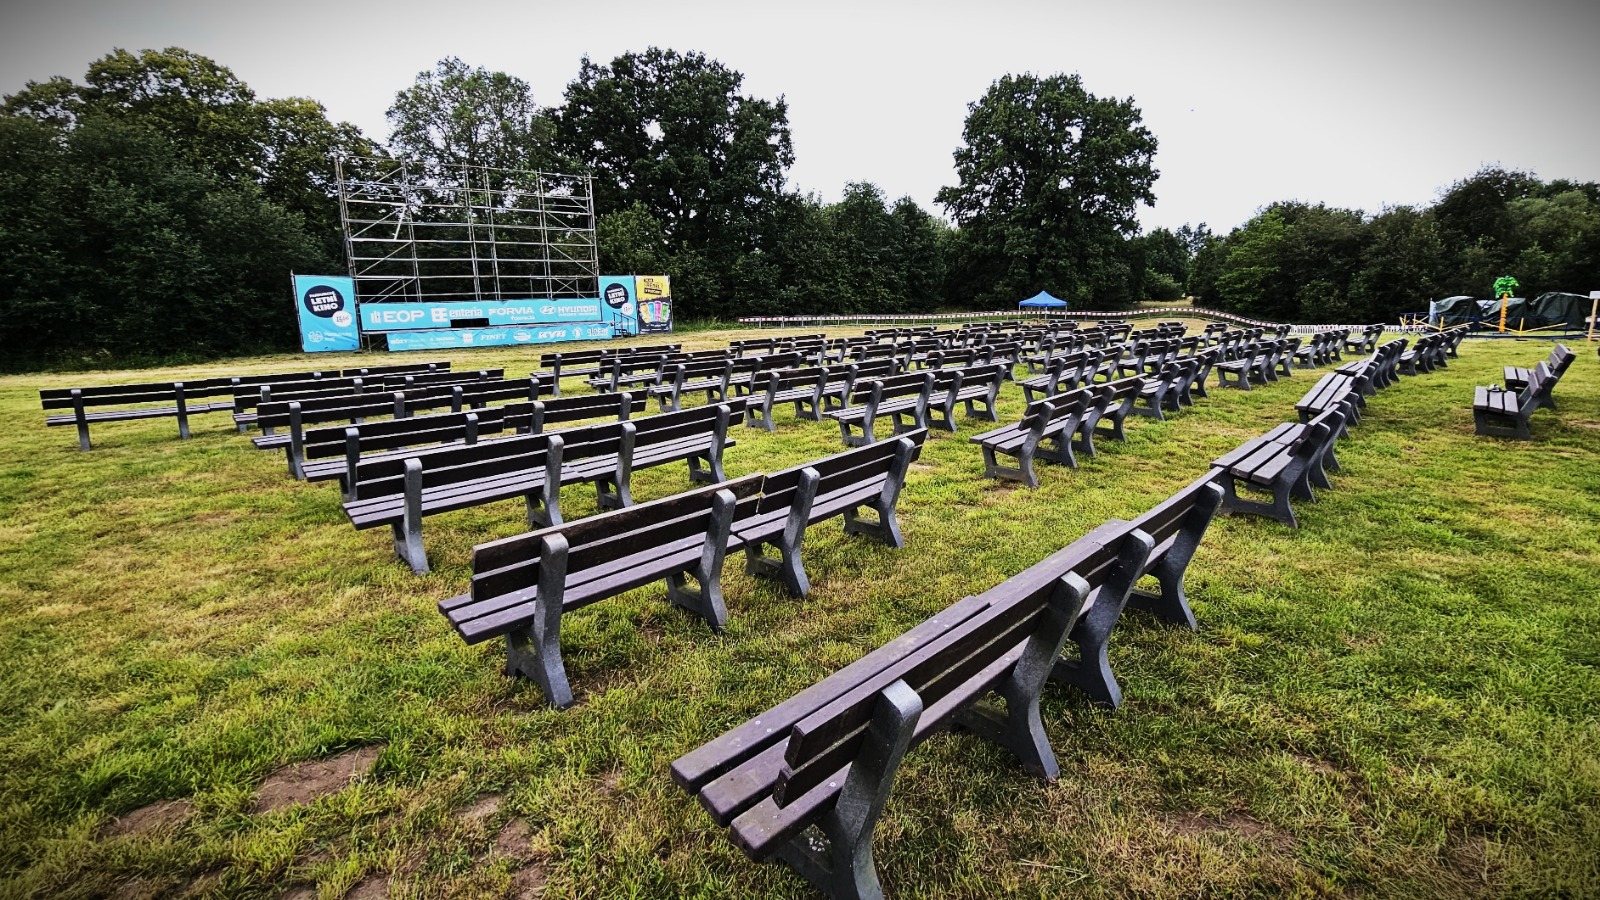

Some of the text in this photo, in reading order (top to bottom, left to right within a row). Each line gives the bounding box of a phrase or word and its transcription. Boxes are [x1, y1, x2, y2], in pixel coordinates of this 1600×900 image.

[313, 303, 338, 312] KINO
[449, 307, 483, 317] enteria
[488, 307, 534, 316] FORVIA
[557, 305, 597, 313] HYUNDAI
[383, 310, 425, 323] EOP
